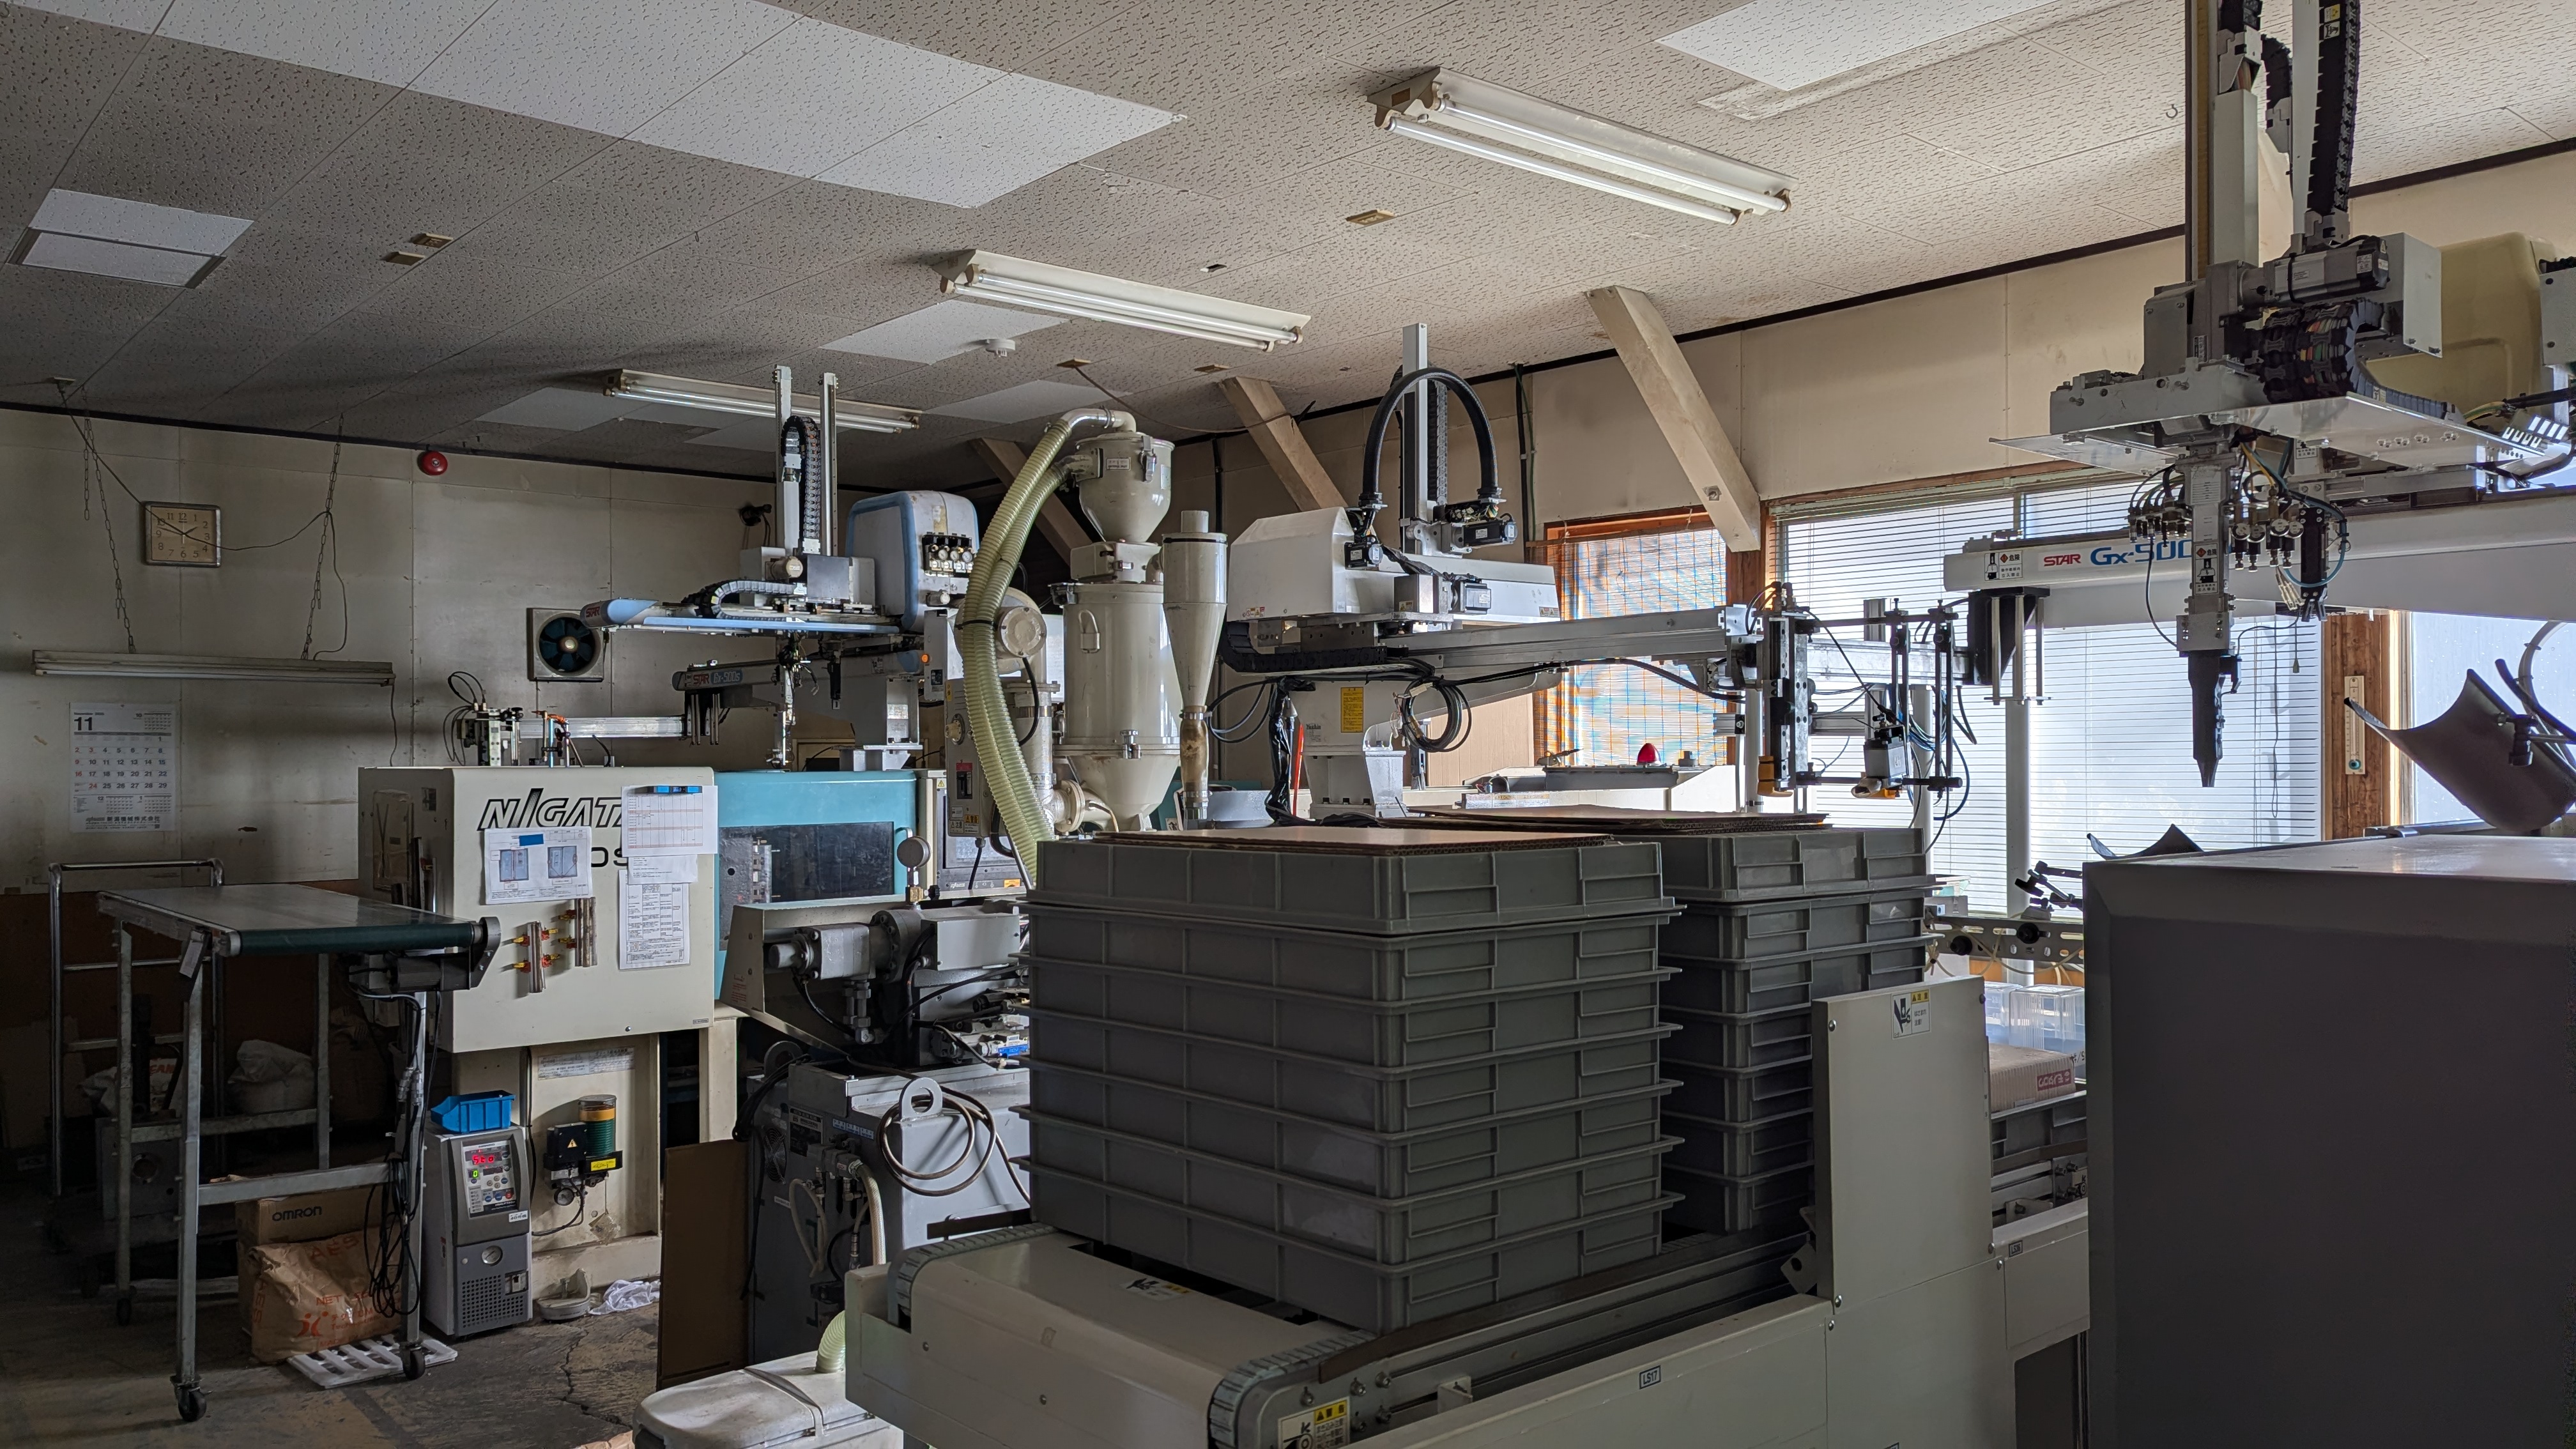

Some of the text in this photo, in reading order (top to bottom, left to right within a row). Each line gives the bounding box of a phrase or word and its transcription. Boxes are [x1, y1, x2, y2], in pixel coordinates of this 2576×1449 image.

[194, 514, 197, 522] 1
[203, 521, 208, 529] 2
[155, 530, 210, 540] 9 3
[158, 542, 208, 553] 8 4
[2044, 553, 2082, 567] STAR
[693, 673, 710, 685] STAR
[74, 717, 93, 731] 11
[272, 1206, 322, 1222] OMRON
[316, 1294, 342, 1306] NET
[1643, 1370, 1658, 1385] LS17
